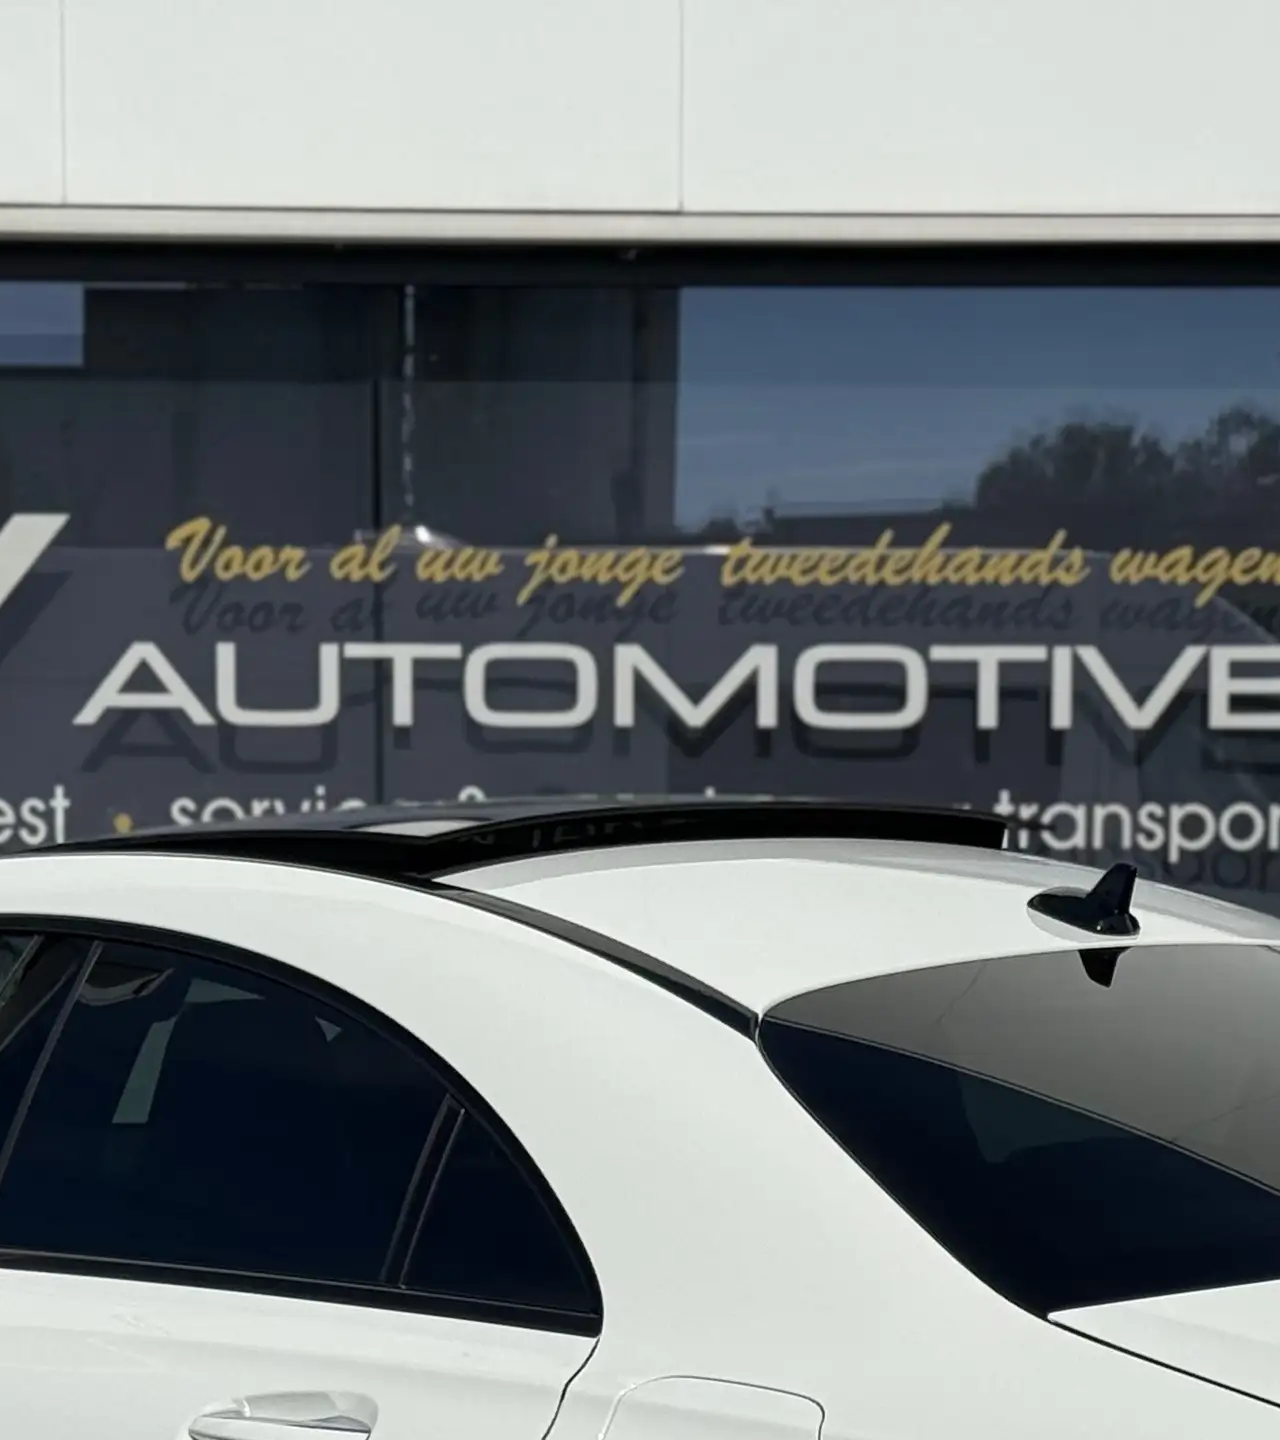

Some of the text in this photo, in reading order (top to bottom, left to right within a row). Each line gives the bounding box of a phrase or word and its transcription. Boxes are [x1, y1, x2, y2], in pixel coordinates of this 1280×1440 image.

[166, 516, 314, 583] Voor
[331, 525, 403, 583] al
[415, 545, 506, 585] uw
[517, 534, 686, 608] jonge
[720, 523, 1091, 587] tweedehands
